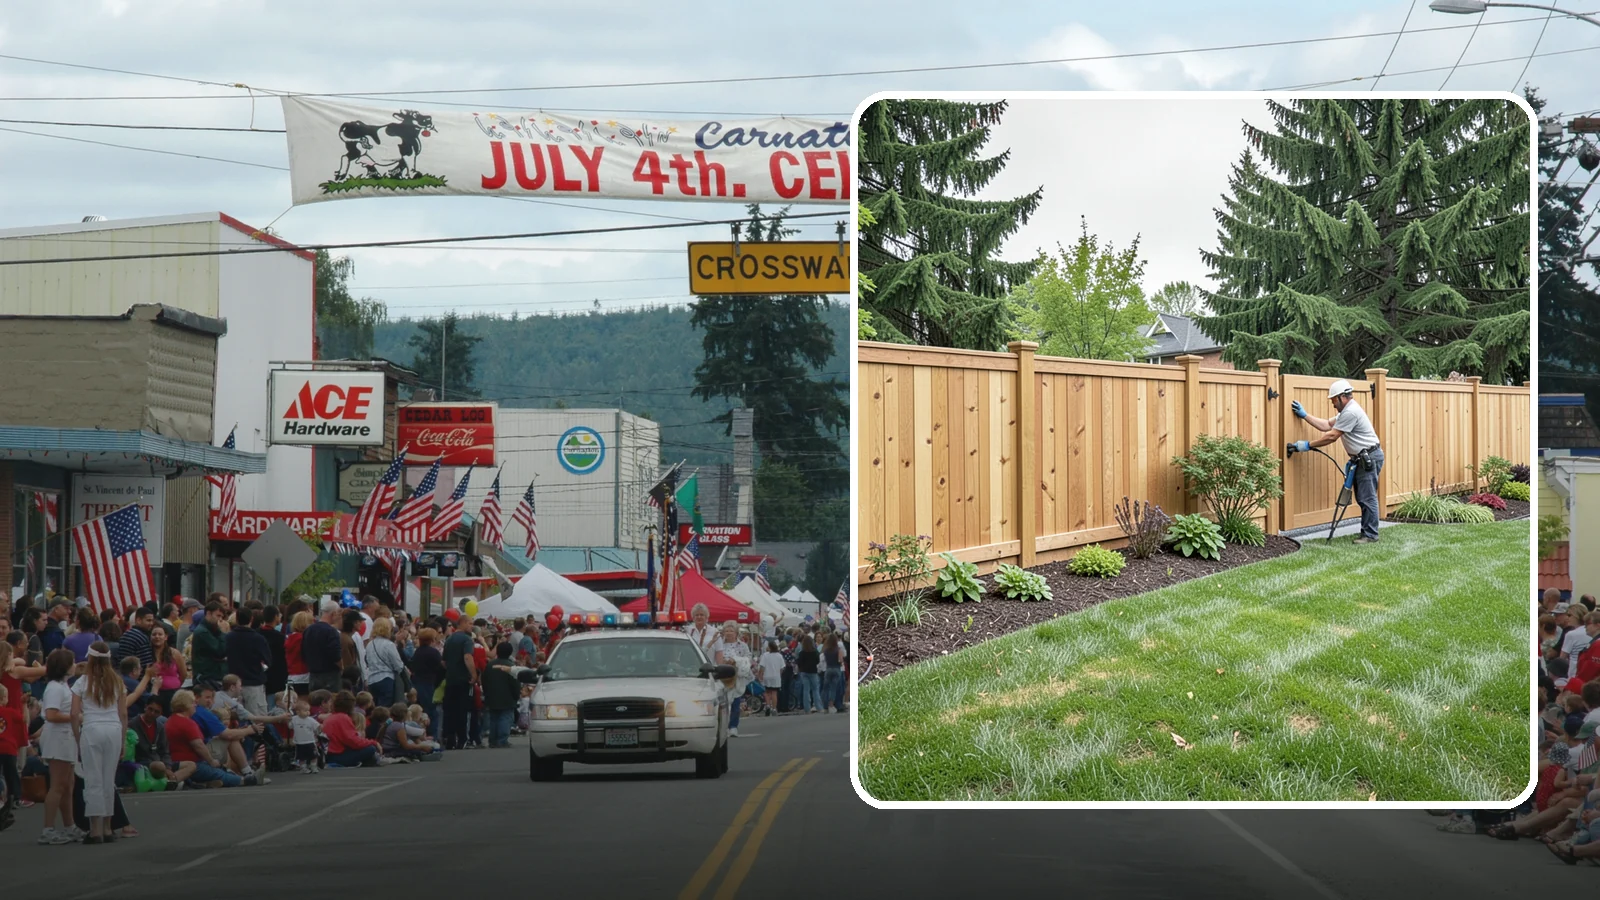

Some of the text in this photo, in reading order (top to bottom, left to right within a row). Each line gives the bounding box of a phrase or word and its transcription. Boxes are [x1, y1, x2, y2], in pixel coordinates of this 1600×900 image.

[481, 141, 604, 192] JULY
[632, 150, 746, 198] 4th.
[697, 254, 850, 280] CROSSWA
[283, 380, 373, 420] ACE
[406, 409, 452, 422] CEDAR
[283, 421, 371, 437] Hardware
[353, 467, 385, 480] Simpl
[96, 485, 124, 494] Vincent
[126, 486, 136, 495] de
[138, 486, 155, 495] Paul
[81, 503, 153, 522] THT
[688, 526, 741, 535] CRNATION
[699, 535, 730, 543] GLASS
